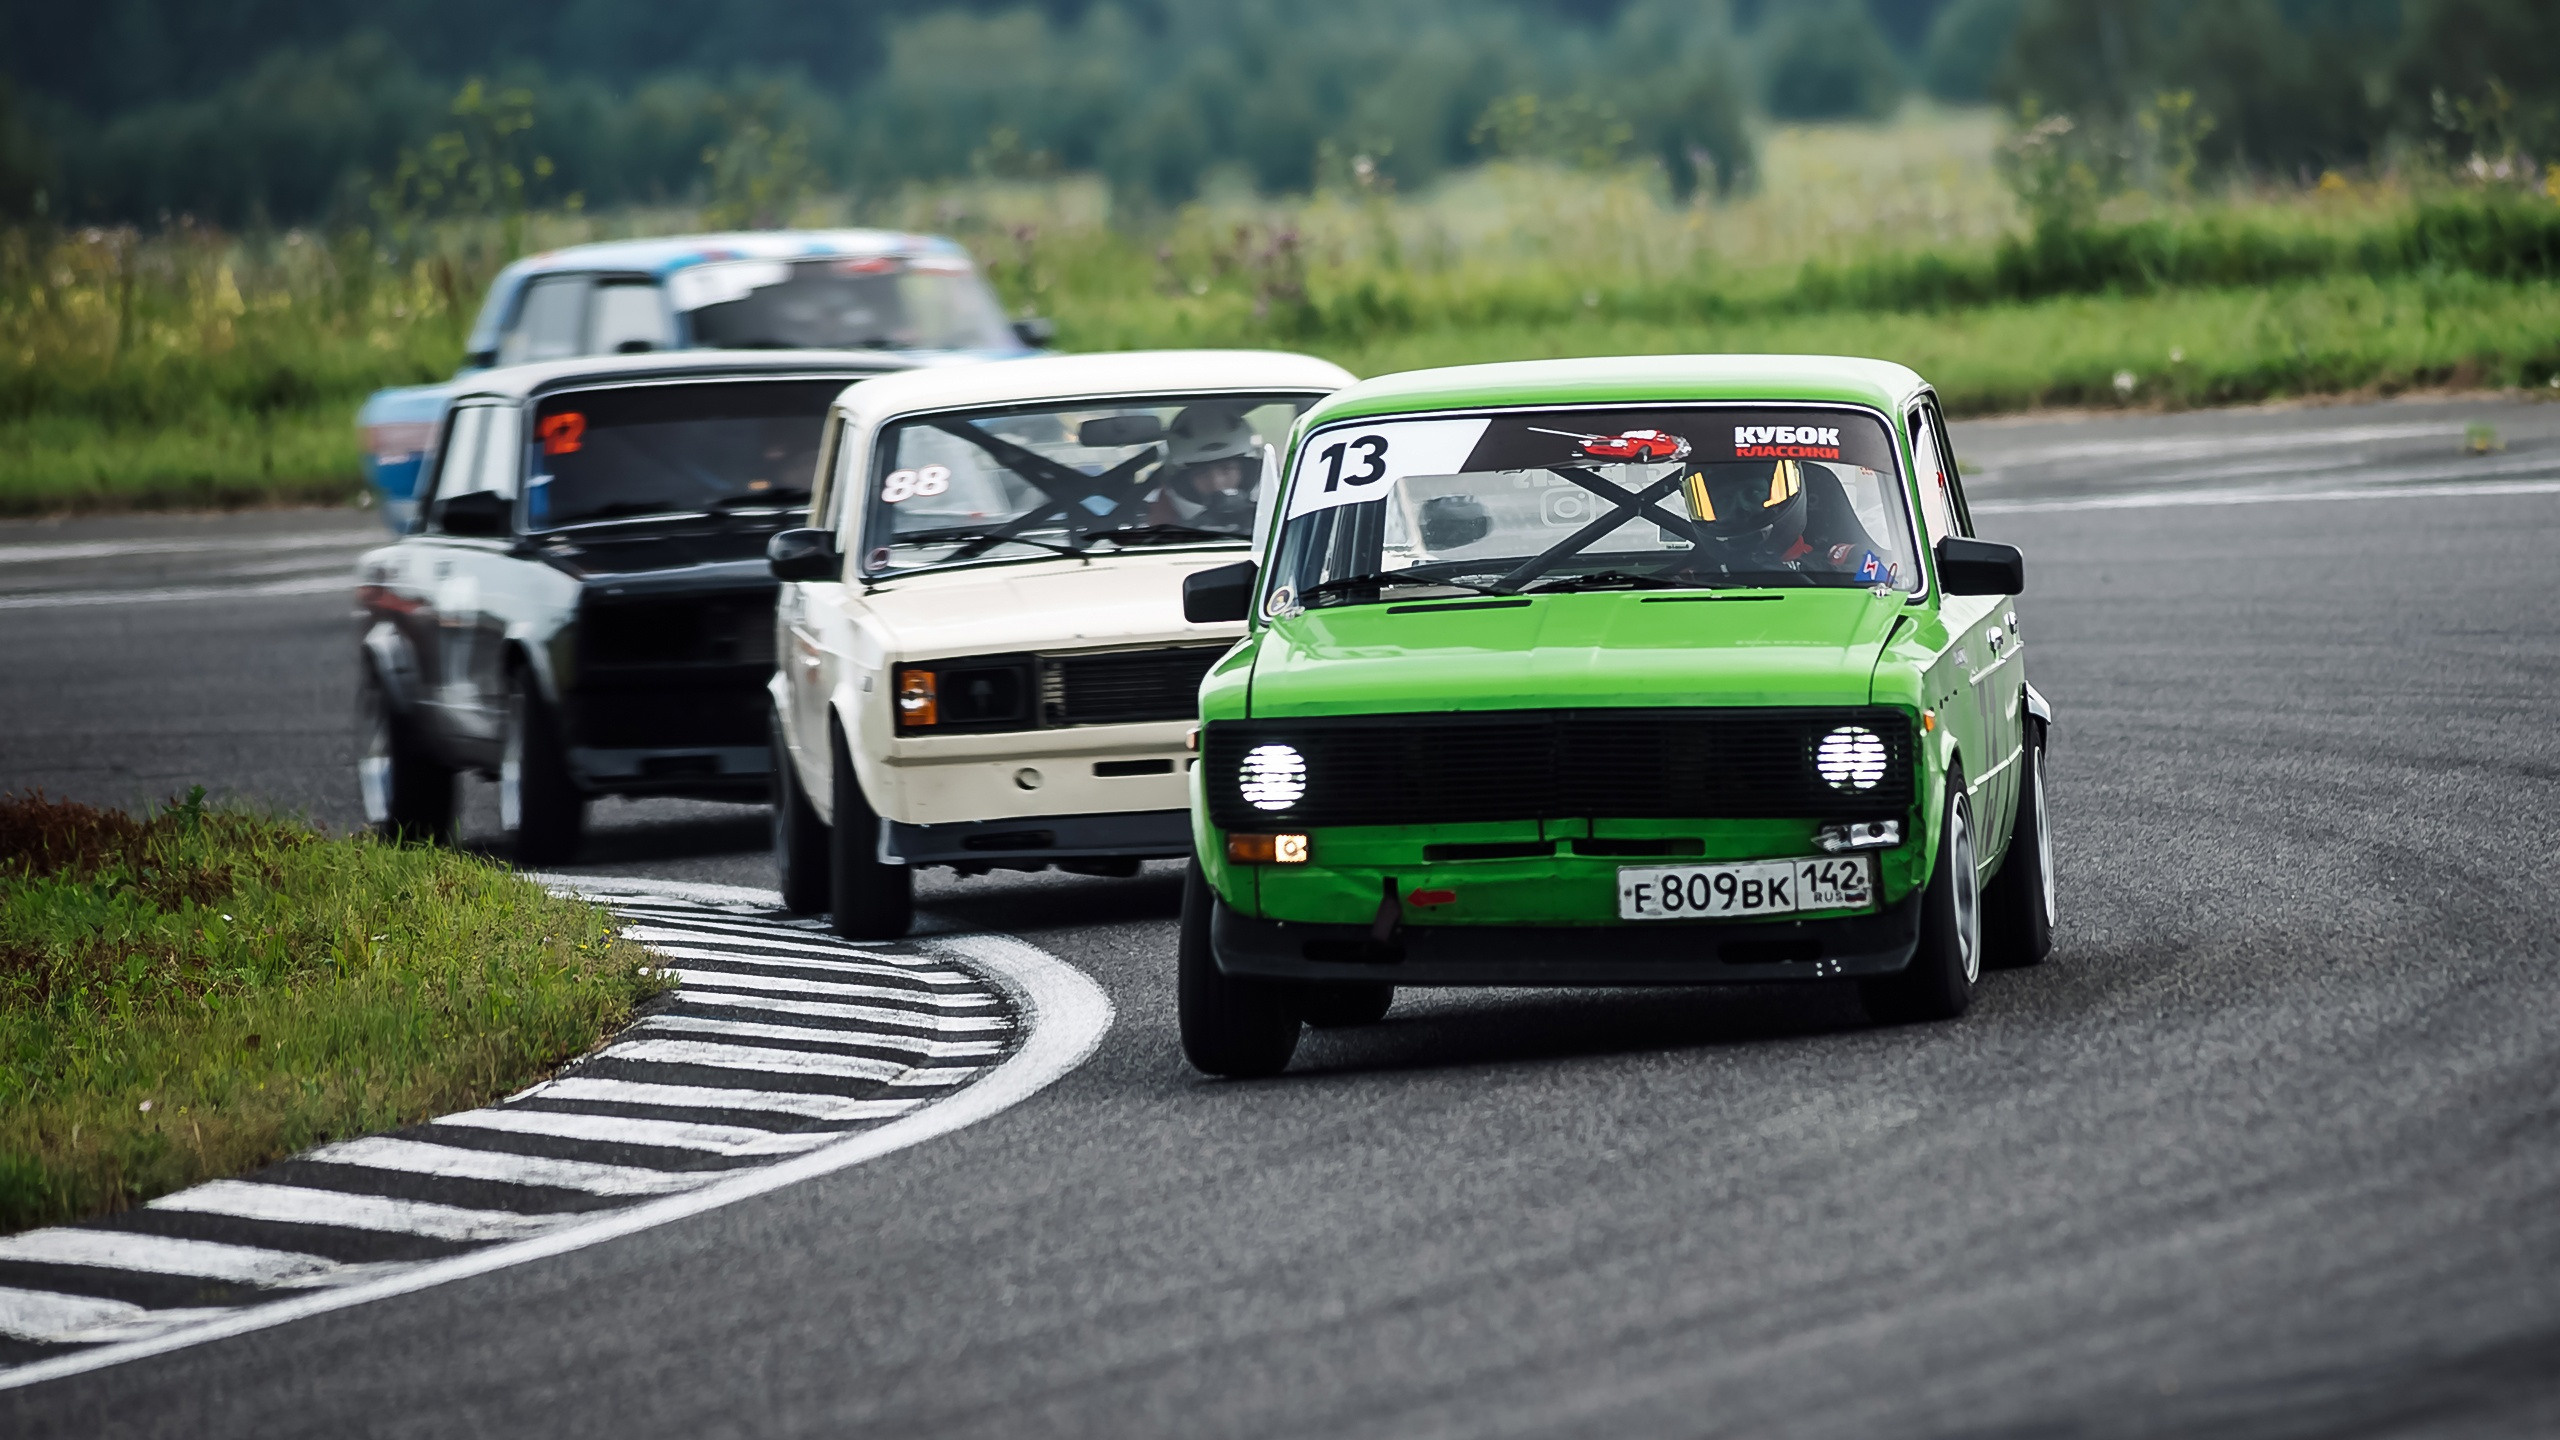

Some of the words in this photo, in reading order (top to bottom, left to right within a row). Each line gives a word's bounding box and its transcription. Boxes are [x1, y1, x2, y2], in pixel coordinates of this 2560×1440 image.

[1735, 426, 1840, 446] КУБОК
[1319, 434, 1389, 493] 13
[1736, 445, 1840, 460] КЛАССИКИ
[881, 464, 951, 504] 88
[1801, 860, 1860, 892] 142
[1813, 890, 1843, 903] RUS
